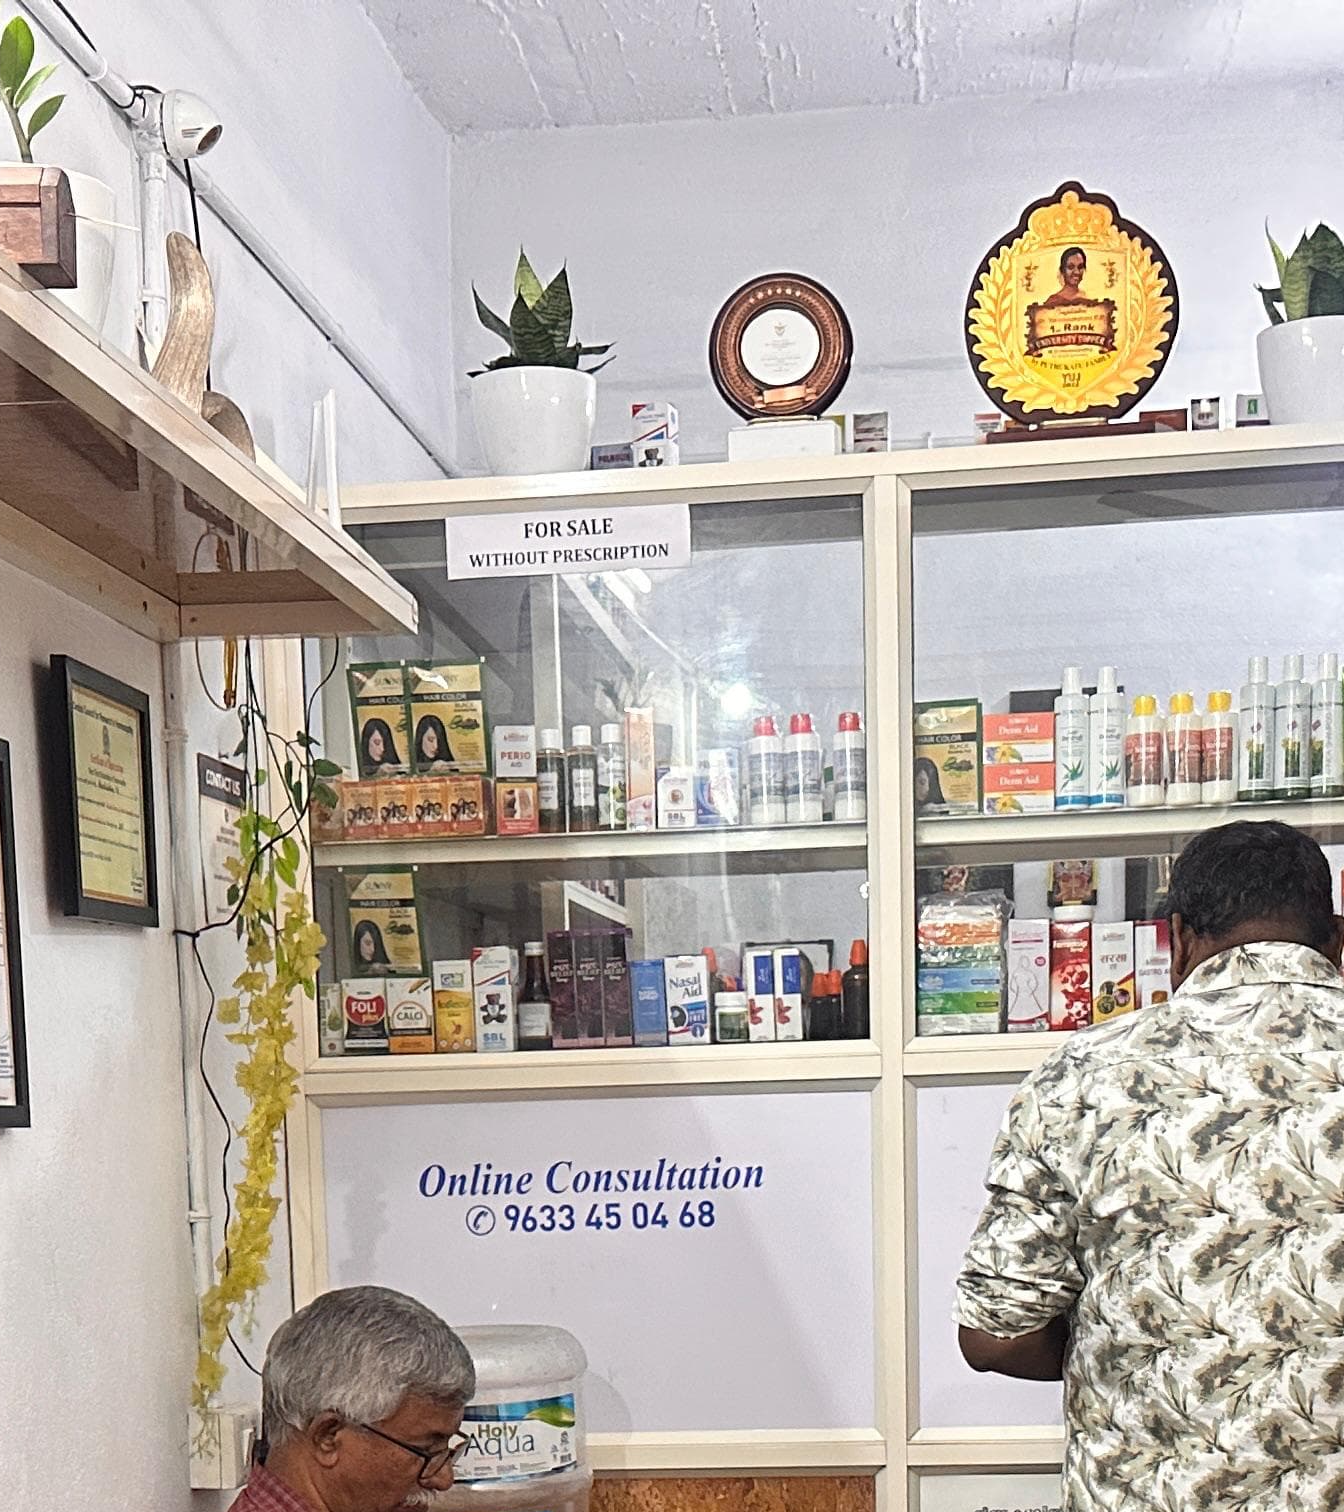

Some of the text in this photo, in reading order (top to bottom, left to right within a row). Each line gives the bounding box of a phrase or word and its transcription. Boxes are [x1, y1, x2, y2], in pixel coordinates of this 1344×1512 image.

[1064, 322, 1095, 331] Rank
[523, 517, 613, 538] FOR SALE
[469, 543, 669, 567] WITHOUT PRESCRIPTION
[998, 725, 1039, 735] Derm Aid
[936, 734, 962, 742] COLOR
[501, 751, 531, 760] PERIO
[999, 776, 1039, 786] Derm Aid
[669, 973, 701, 989] Nasal
[682, 986, 702, 999] Aid
[351, 1001, 377, 1013] FOLI
[396, 1010, 423, 1021] CALCI
[482, 1032, 506, 1042] SBL
[419, 1156, 764, 1198] Online Consultation
[503, 1200, 716, 1232] 9633 45 04 68
[477, 1423, 518, 1440] Holy
[463, 1432, 535, 1461] Aqua
